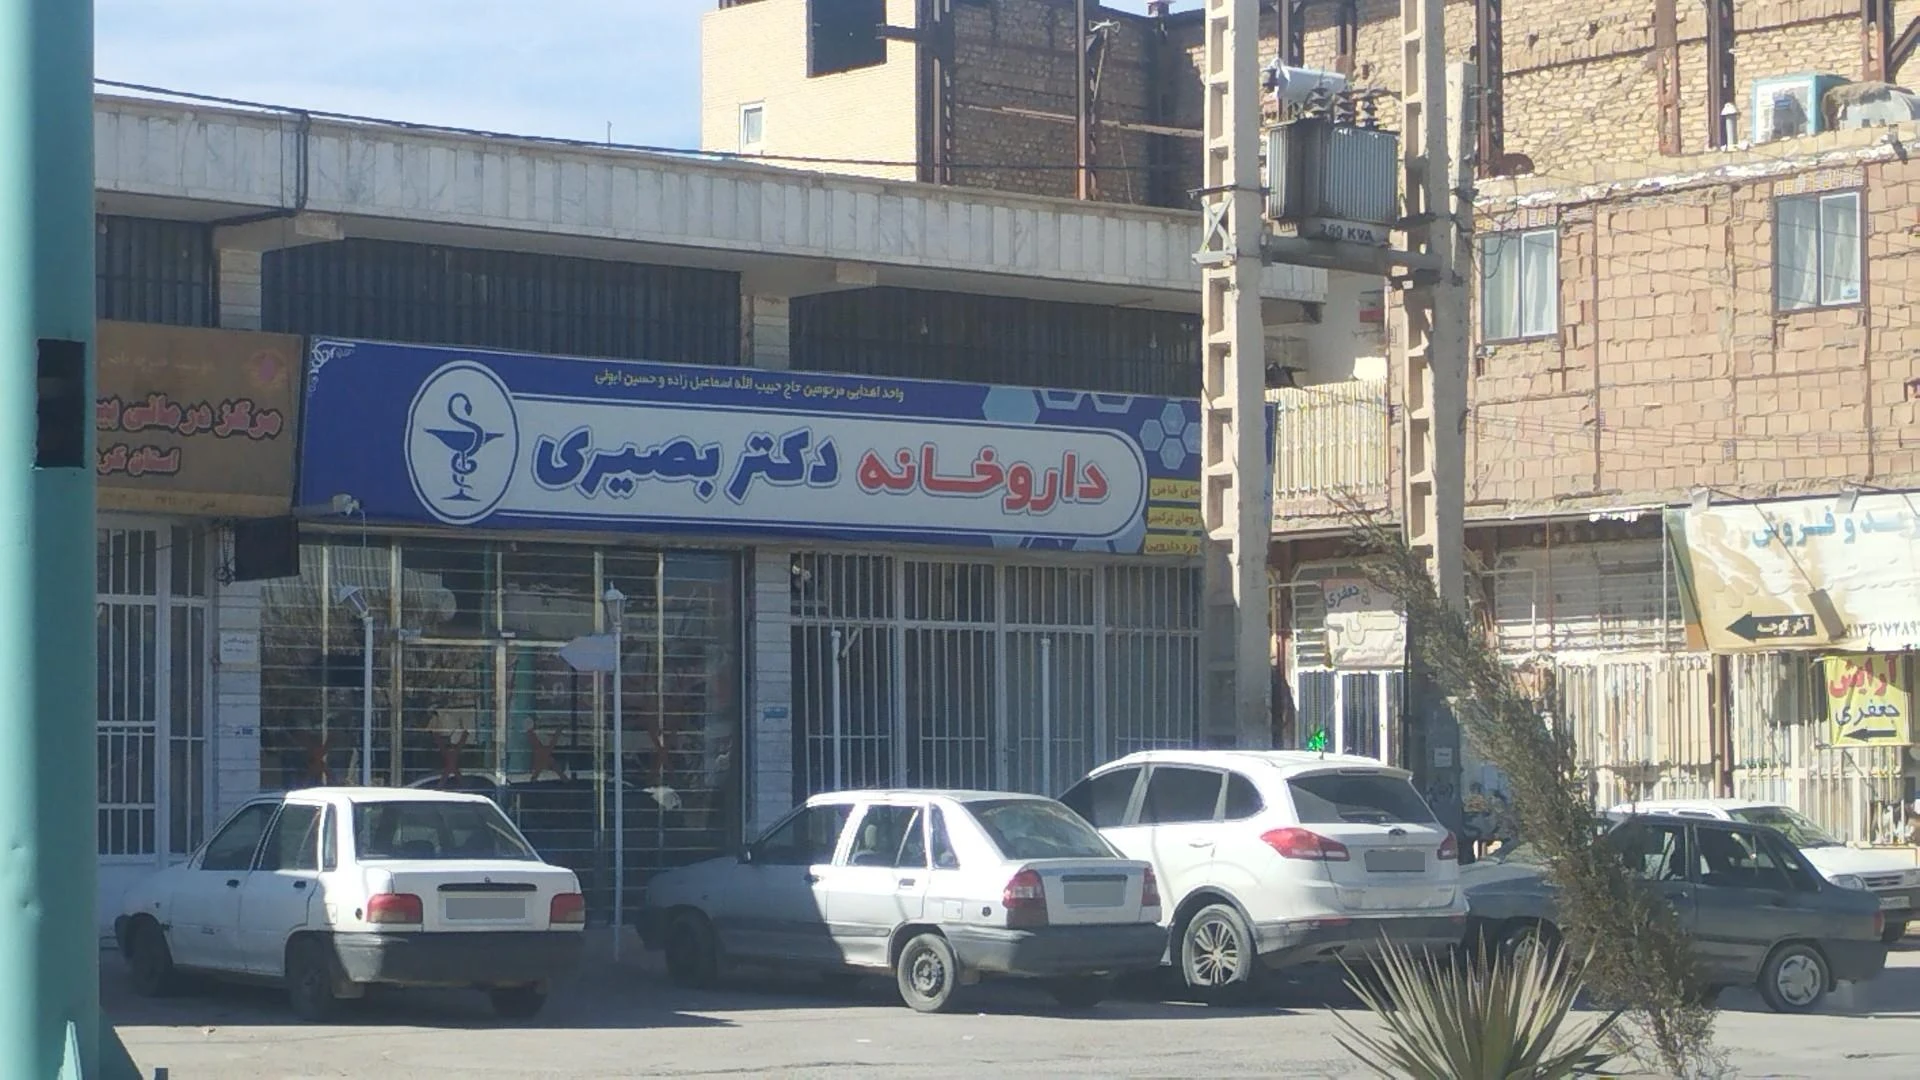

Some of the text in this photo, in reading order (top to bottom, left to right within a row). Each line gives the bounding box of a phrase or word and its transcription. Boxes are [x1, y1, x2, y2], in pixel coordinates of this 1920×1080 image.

[1347, 227, 1375, 242] KVA
[623, 373, 657, 387] حسین
[657, 375, 665, 389] و
[667, 373, 688, 390] زاده
[734, 374, 753, 390] الله
[754, 382, 782, 395] حبیب
[783, 380, 802, 399] حاج
[881, 387, 905, 403] واحد
[213, 398, 283, 440] مرکز
[531, 424, 1112, 516] داروخانه دکتر بصیری
[1753, 505, 1836, 548] فروش
[1844, 518, 1856, 544] و
[1835, 699, 1900, 726] جعفری
